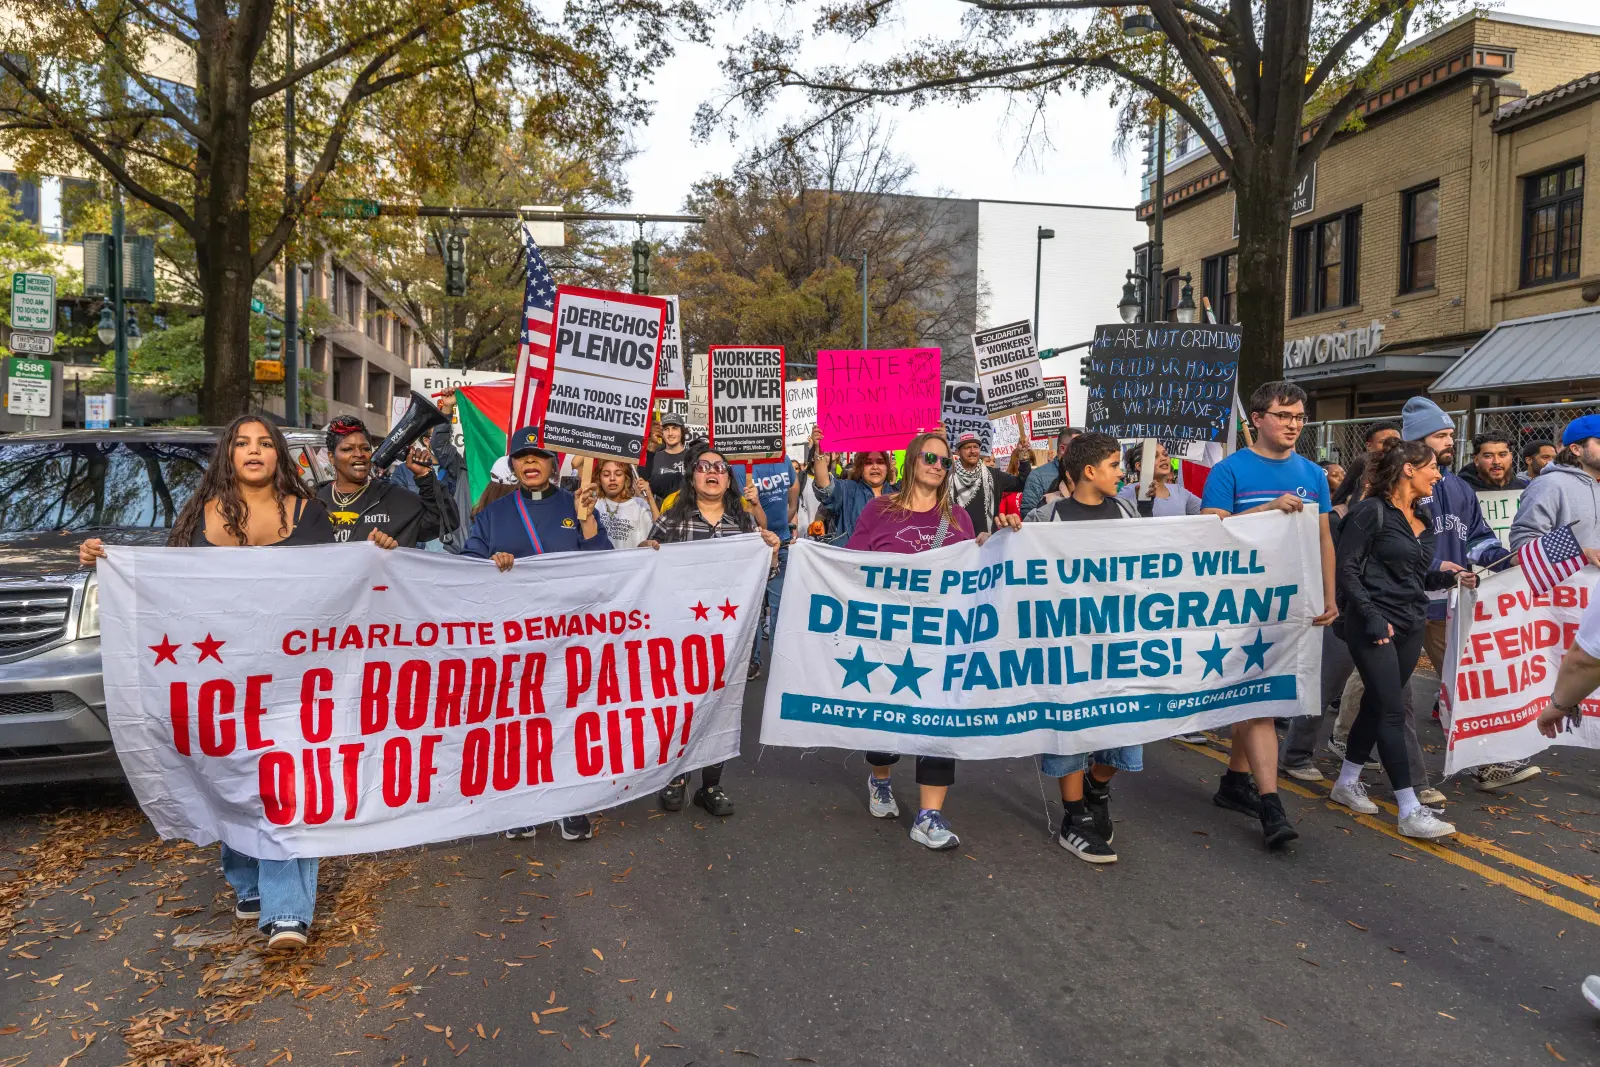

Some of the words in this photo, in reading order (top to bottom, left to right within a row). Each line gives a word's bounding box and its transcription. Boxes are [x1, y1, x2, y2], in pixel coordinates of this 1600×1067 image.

[16, 275, 24, 285] 2
[27, 277, 50, 286] METERED
[27, 285, 49, 293] PARKING
[560, 305, 659, 339] ¡DERECHOS
[17, 335, 29, 343] THIS
[981, 327, 1024, 344] SOLIDARITY!
[986, 335, 1032, 355] WORKERS'
[1114, 328, 1144, 349] ARE
[1146, 329, 1180, 349] NOT
[29, 343, 44, 351] SIGN
[555, 328, 655, 370] PLENOS
[16, 363, 45, 372] 4586
[713, 351, 781, 366] WORKERS
[979, 346, 1036, 370] STRUGGLE
[1109, 356, 1155, 377] BUILD
[713, 367, 753, 379] SHOULD
[756, 367, 782, 378] HAVE
[826, 354, 900, 386] HATE
[992, 369, 1013, 386] HAS
[1015, 367, 1030, 379] NO
[550, 383, 580, 400] PARA
[584, 388, 621, 406] TODOS
[625, 395, 648, 411] LOS
[714, 379, 781, 399] POWER
[987, 376, 1039, 399] BORDERS!
[1113, 381, 1154, 399] GROW
[1185, 381, 1229, 400] FOOD
[1089, 400, 1105, 414] ICE
[1440, 394, 1459, 404] 330
[546, 398, 646, 428] INMIGRANTES!
[715, 406, 747, 423] NOT
[751, 405, 782, 422] THE
[823, 412, 897, 433] AMERICA
[1037, 410, 1051, 420] HAS
[1052, 409, 1062, 418] NO
[1092, 407, 1110, 422] OUT!
[715, 423, 782, 435] BILLIONAIRES!
[944, 417, 992, 430] AHORA
[1033, 418, 1067, 428] BORDERS!
[1125, 423, 1173, 438] AMERICA
[543, 432, 574, 444] Liberation
[582, 438, 622, 452] PSLWeb.org
[544, 424, 561, 435] Party
[561, 426, 570, 435] for
[571, 428, 602, 440] Socialism
[602, 434, 615, 442] and
[752, 472, 791, 491] HOPE
[919, 528, 935, 542] hope
[860, 565, 932, 593] THE
[940, 558, 1048, 595] PEOPLE
[1056, 552, 1183, 584] UNITED
[1192, 549, 1266, 577] WILL
[807, 593, 1000, 646] DEFEND
[1017, 584, 1298, 639] IMMIGRANT
[282, 621, 496, 656] CHARLOTTE
[503, 609, 651, 643] DEMANDS:
[942, 637, 1183, 692] FAMILIES!
[170, 674, 275, 757] ICE
[361, 652, 547, 736] BORDER
[565, 633, 726, 708] PATROL
[811, 702, 868, 720] PARTY
[873, 708, 907, 725] FOR
[911, 713, 999, 728] SOCIALISM
[1005, 708, 1039, 726] AND
[1044, 701, 1141, 722] LIBERATION
[1166, 682, 1272, 713] @PSLCHARLOTTE
[258, 742, 365, 826] OUT
[382, 734, 443, 808] OF
[459, 717, 554, 798] OUR
[574, 701, 694, 777] CITY!
